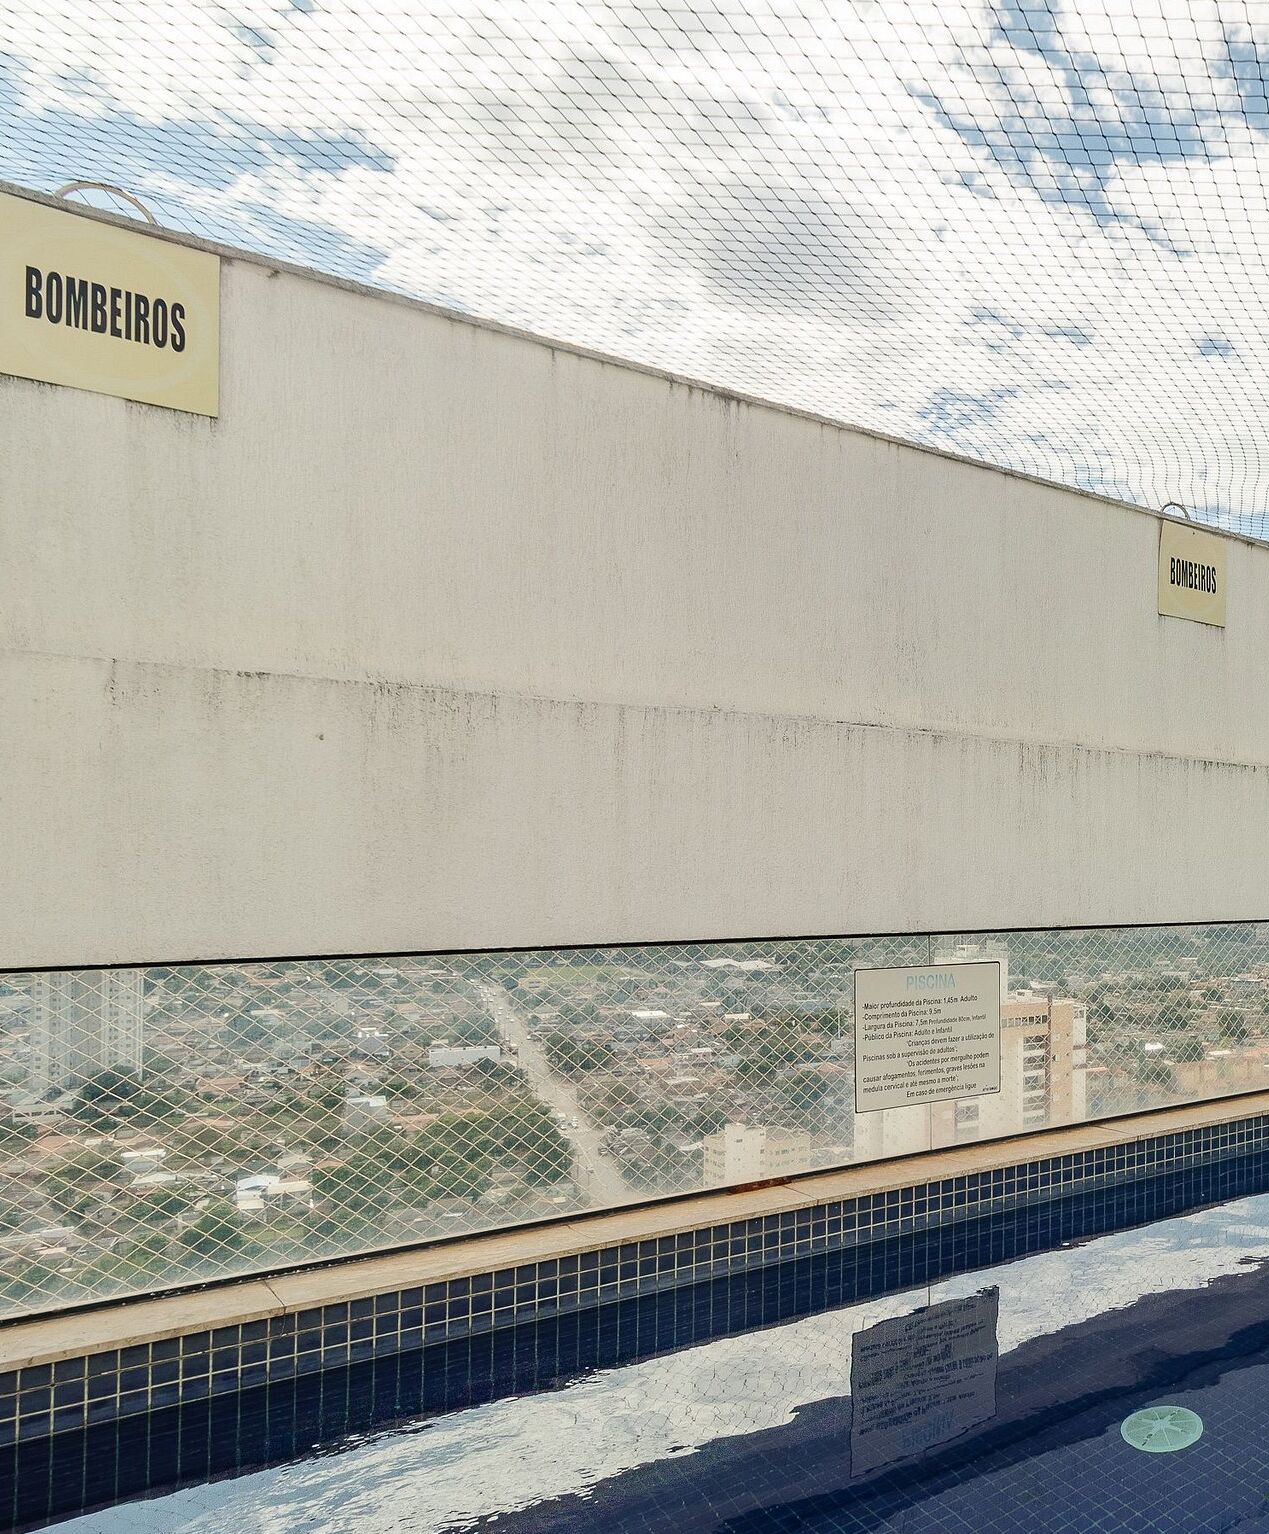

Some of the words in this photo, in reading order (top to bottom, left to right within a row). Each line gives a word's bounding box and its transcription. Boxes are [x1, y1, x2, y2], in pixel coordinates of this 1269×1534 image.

[25, 265, 186, 352] BOMBEIROS
[1170, 557, 1216, 594] BOMBEIROS
[906, 973, 956, 990] PISCINA
[881, 1000, 914, 1010] profundidade
[928, 1017, 958, 1025] Profundidade
[948, 1034, 960, 1042] fazer
[965, 1032, 988, 1040] utilização
[862, 1054, 886, 1062] Piscinas
[902, 1049, 928, 1058] supervisão
[916, 1058, 940, 1066] acidentes
[950, 1054, 973, 1062] mergulho
[974, 1052, 990, 1060] podem
[946, 1065, 962, 1074] graves
[884, 1082, 904, 1090] cervical
[936, 1084, 964, 1094] emergência
[964, 1082, 976, 1090] ligue
